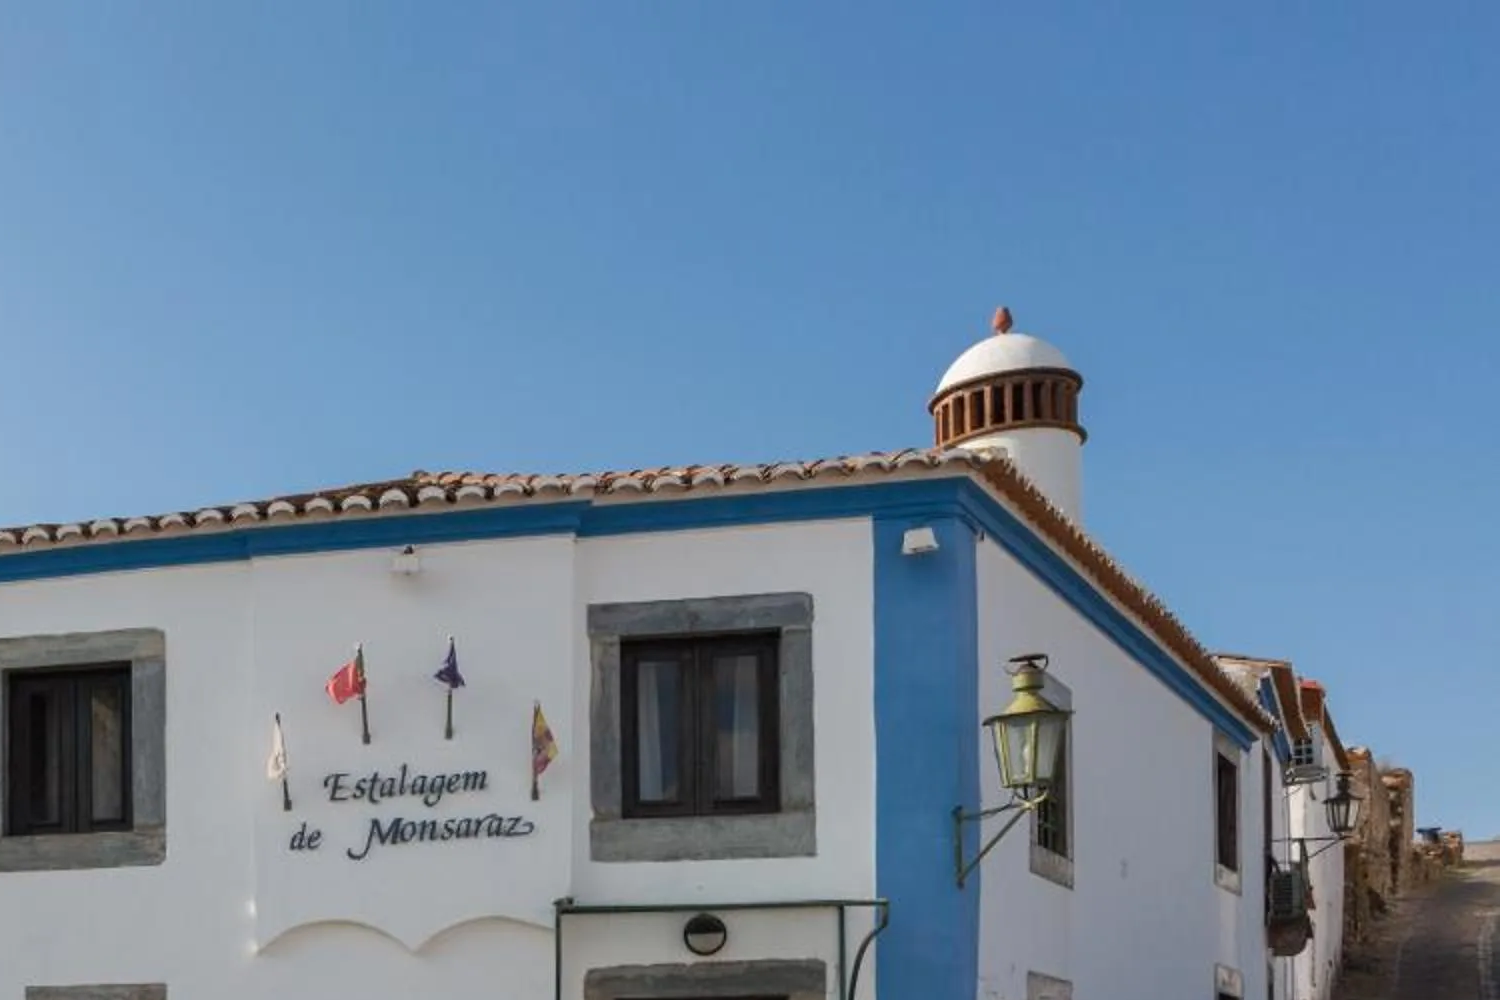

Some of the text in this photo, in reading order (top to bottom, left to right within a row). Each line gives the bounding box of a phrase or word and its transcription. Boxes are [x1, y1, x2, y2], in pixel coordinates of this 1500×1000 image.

[323, 763, 488, 807] Estalagem
[289, 813, 535, 860] de Monsaraz
